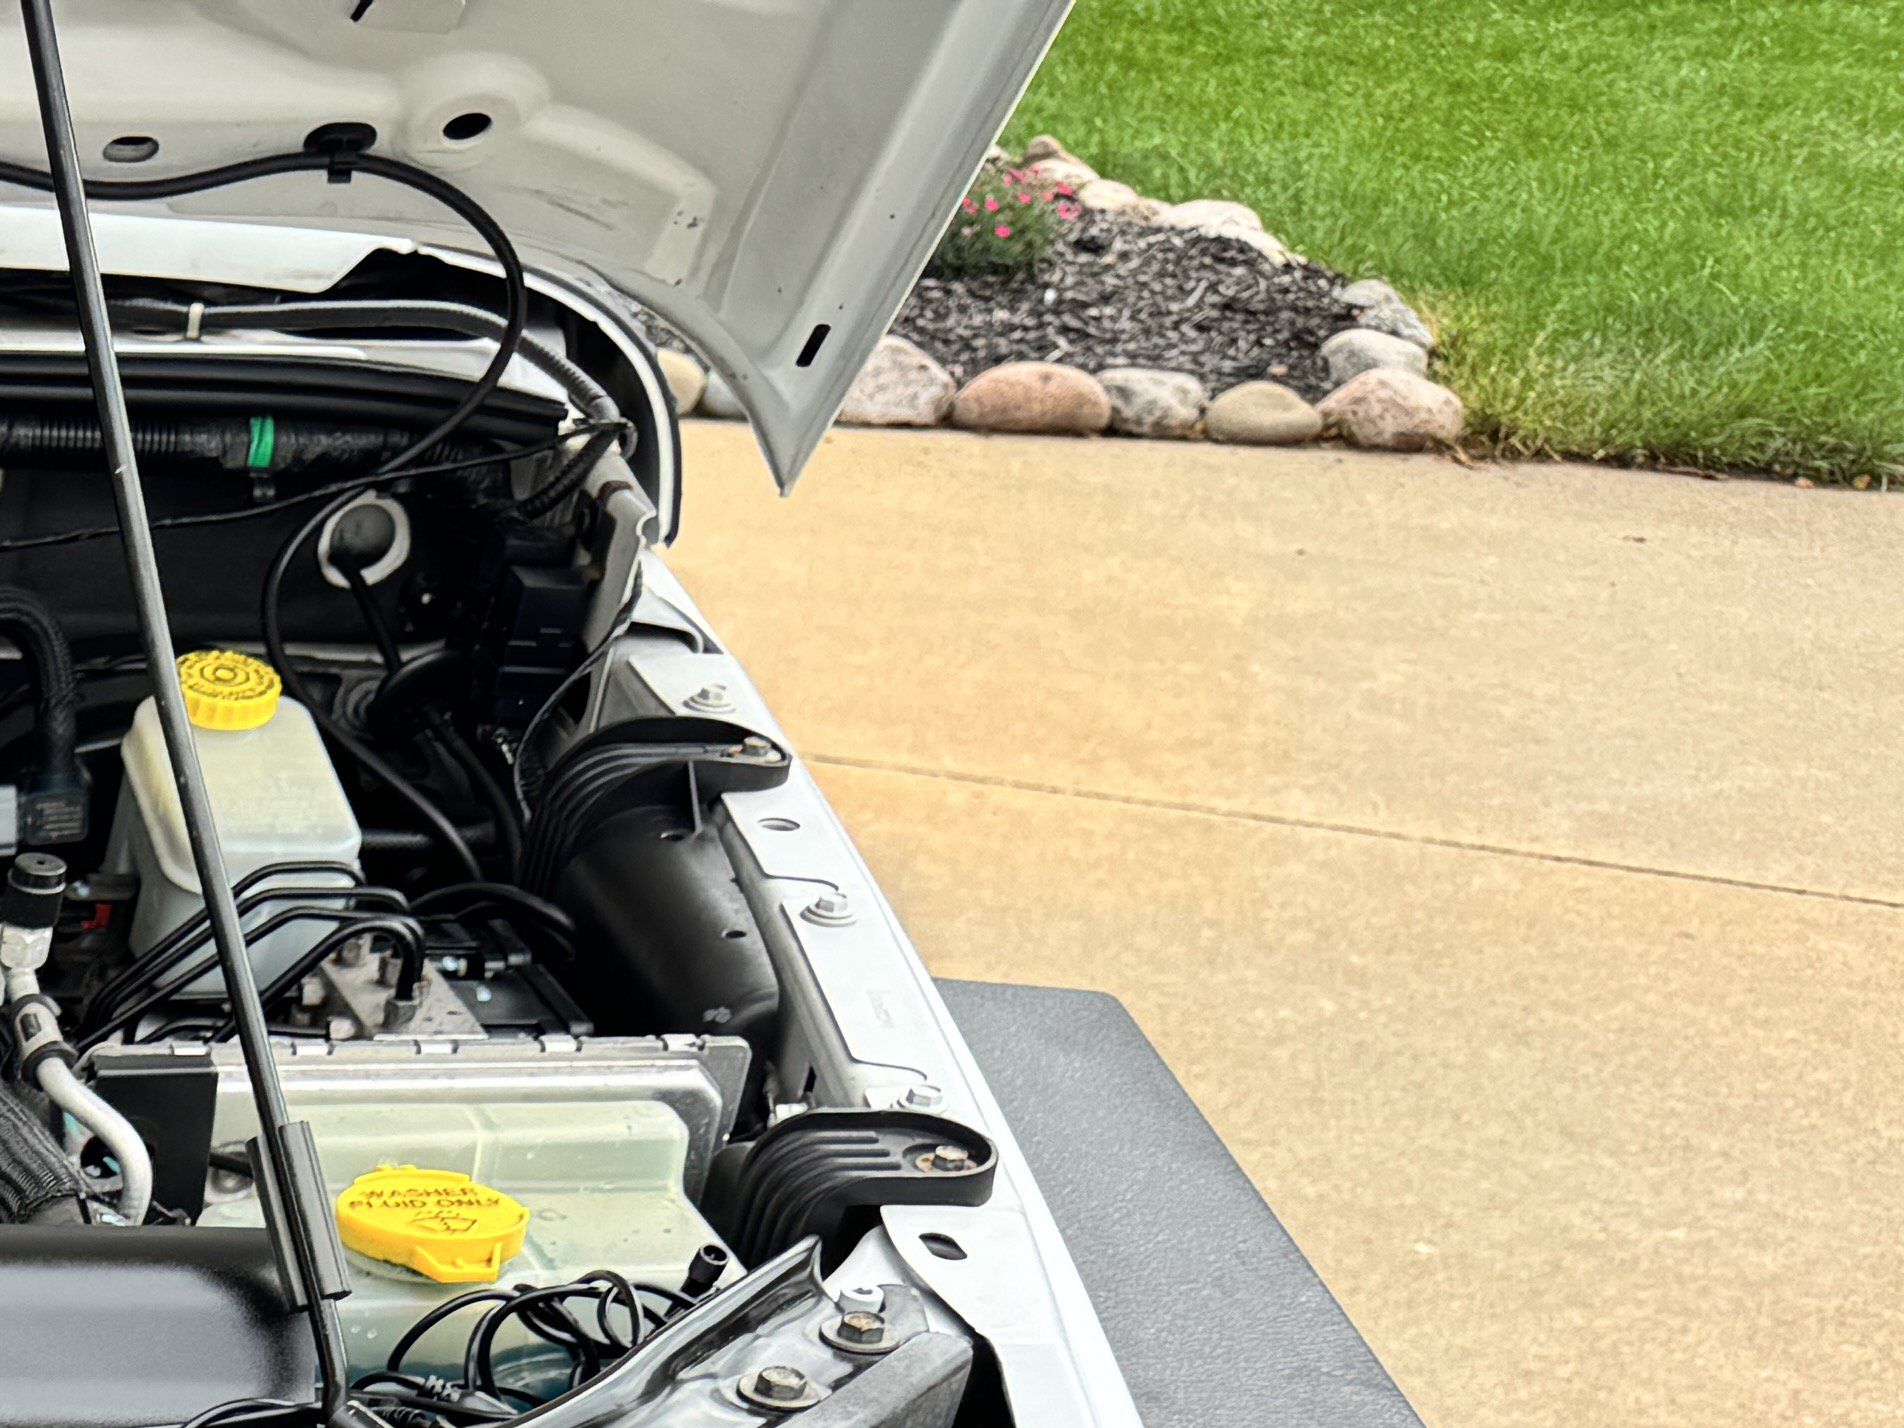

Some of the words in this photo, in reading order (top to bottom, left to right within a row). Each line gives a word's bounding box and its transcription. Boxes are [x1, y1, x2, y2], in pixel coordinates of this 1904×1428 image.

[359, 1187, 479, 1199] WASHER
[348, 1198, 428, 1209] FLUID
[436, 1197, 501, 1209] ONLY
